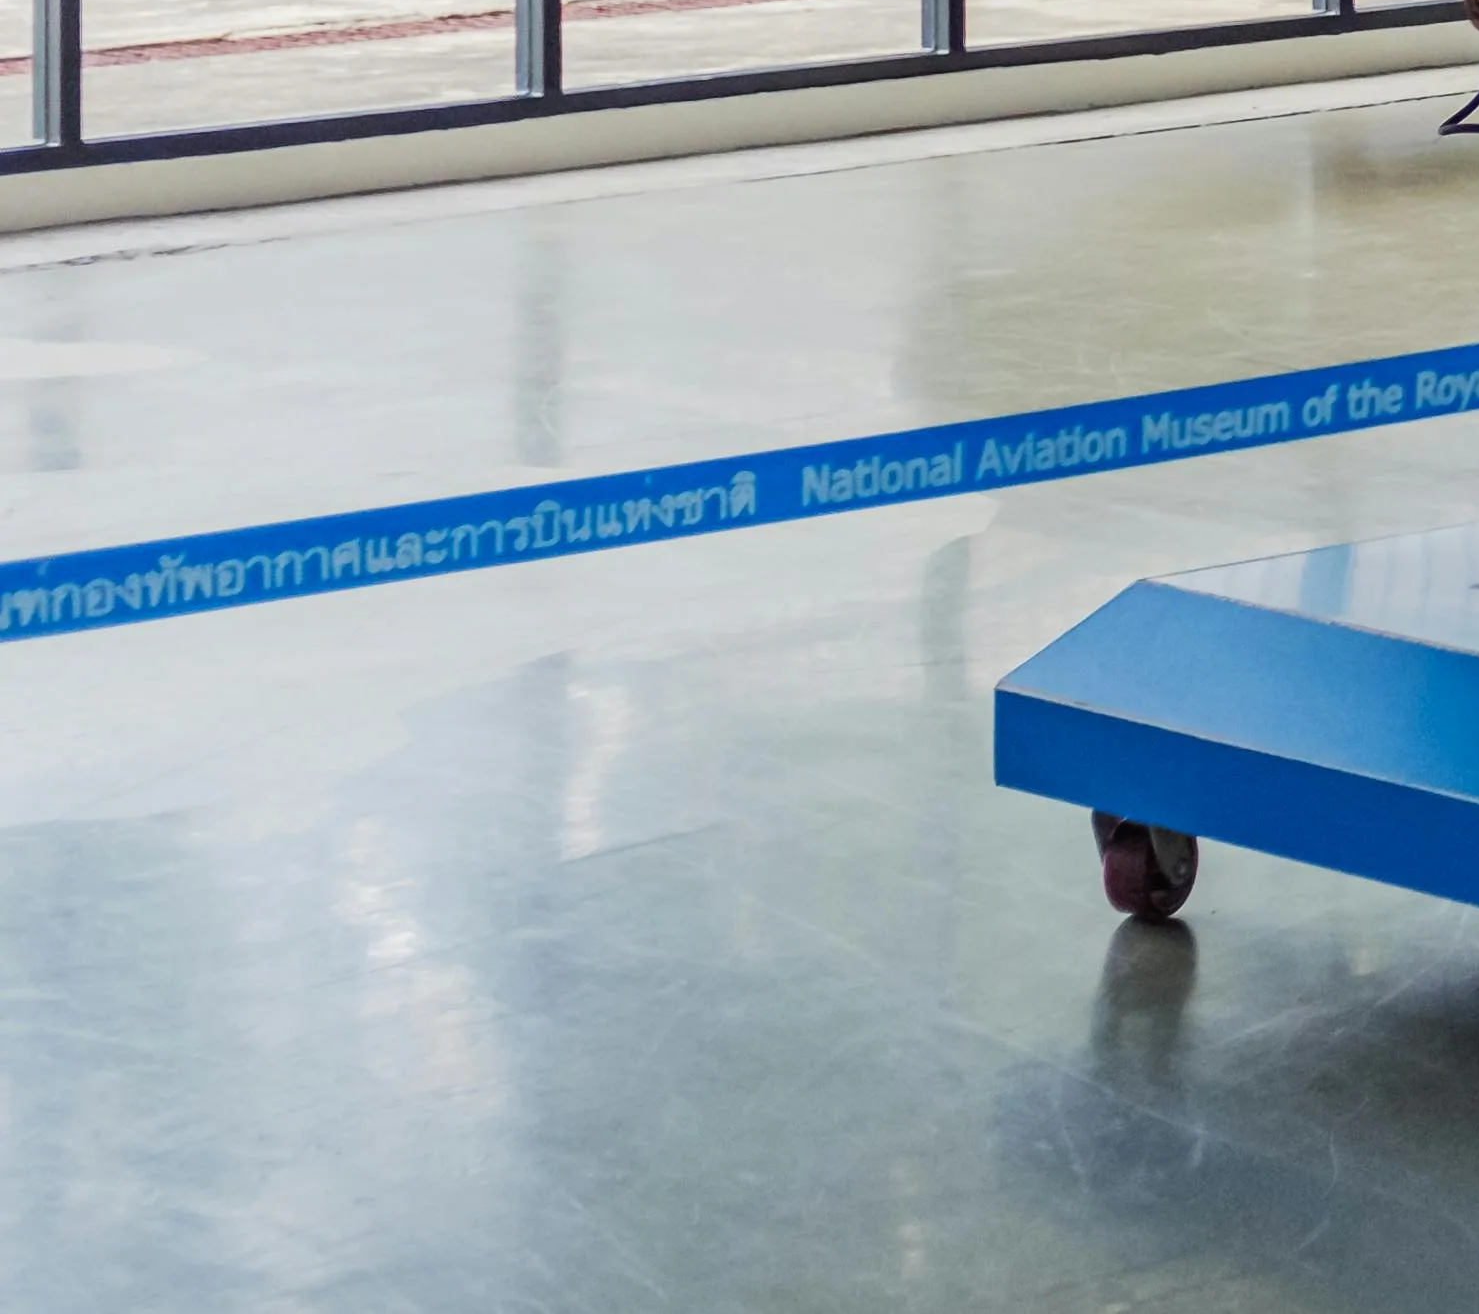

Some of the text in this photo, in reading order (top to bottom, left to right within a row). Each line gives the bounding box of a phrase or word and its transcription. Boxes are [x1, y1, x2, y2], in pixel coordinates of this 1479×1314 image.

[802, 443, 962, 506] National
[976, 426, 1127, 483] Aviation
[1142, 403, 1290, 455] Museum
[1302, 383, 1339, 429] of
[1347, 376, 1404, 424] the
